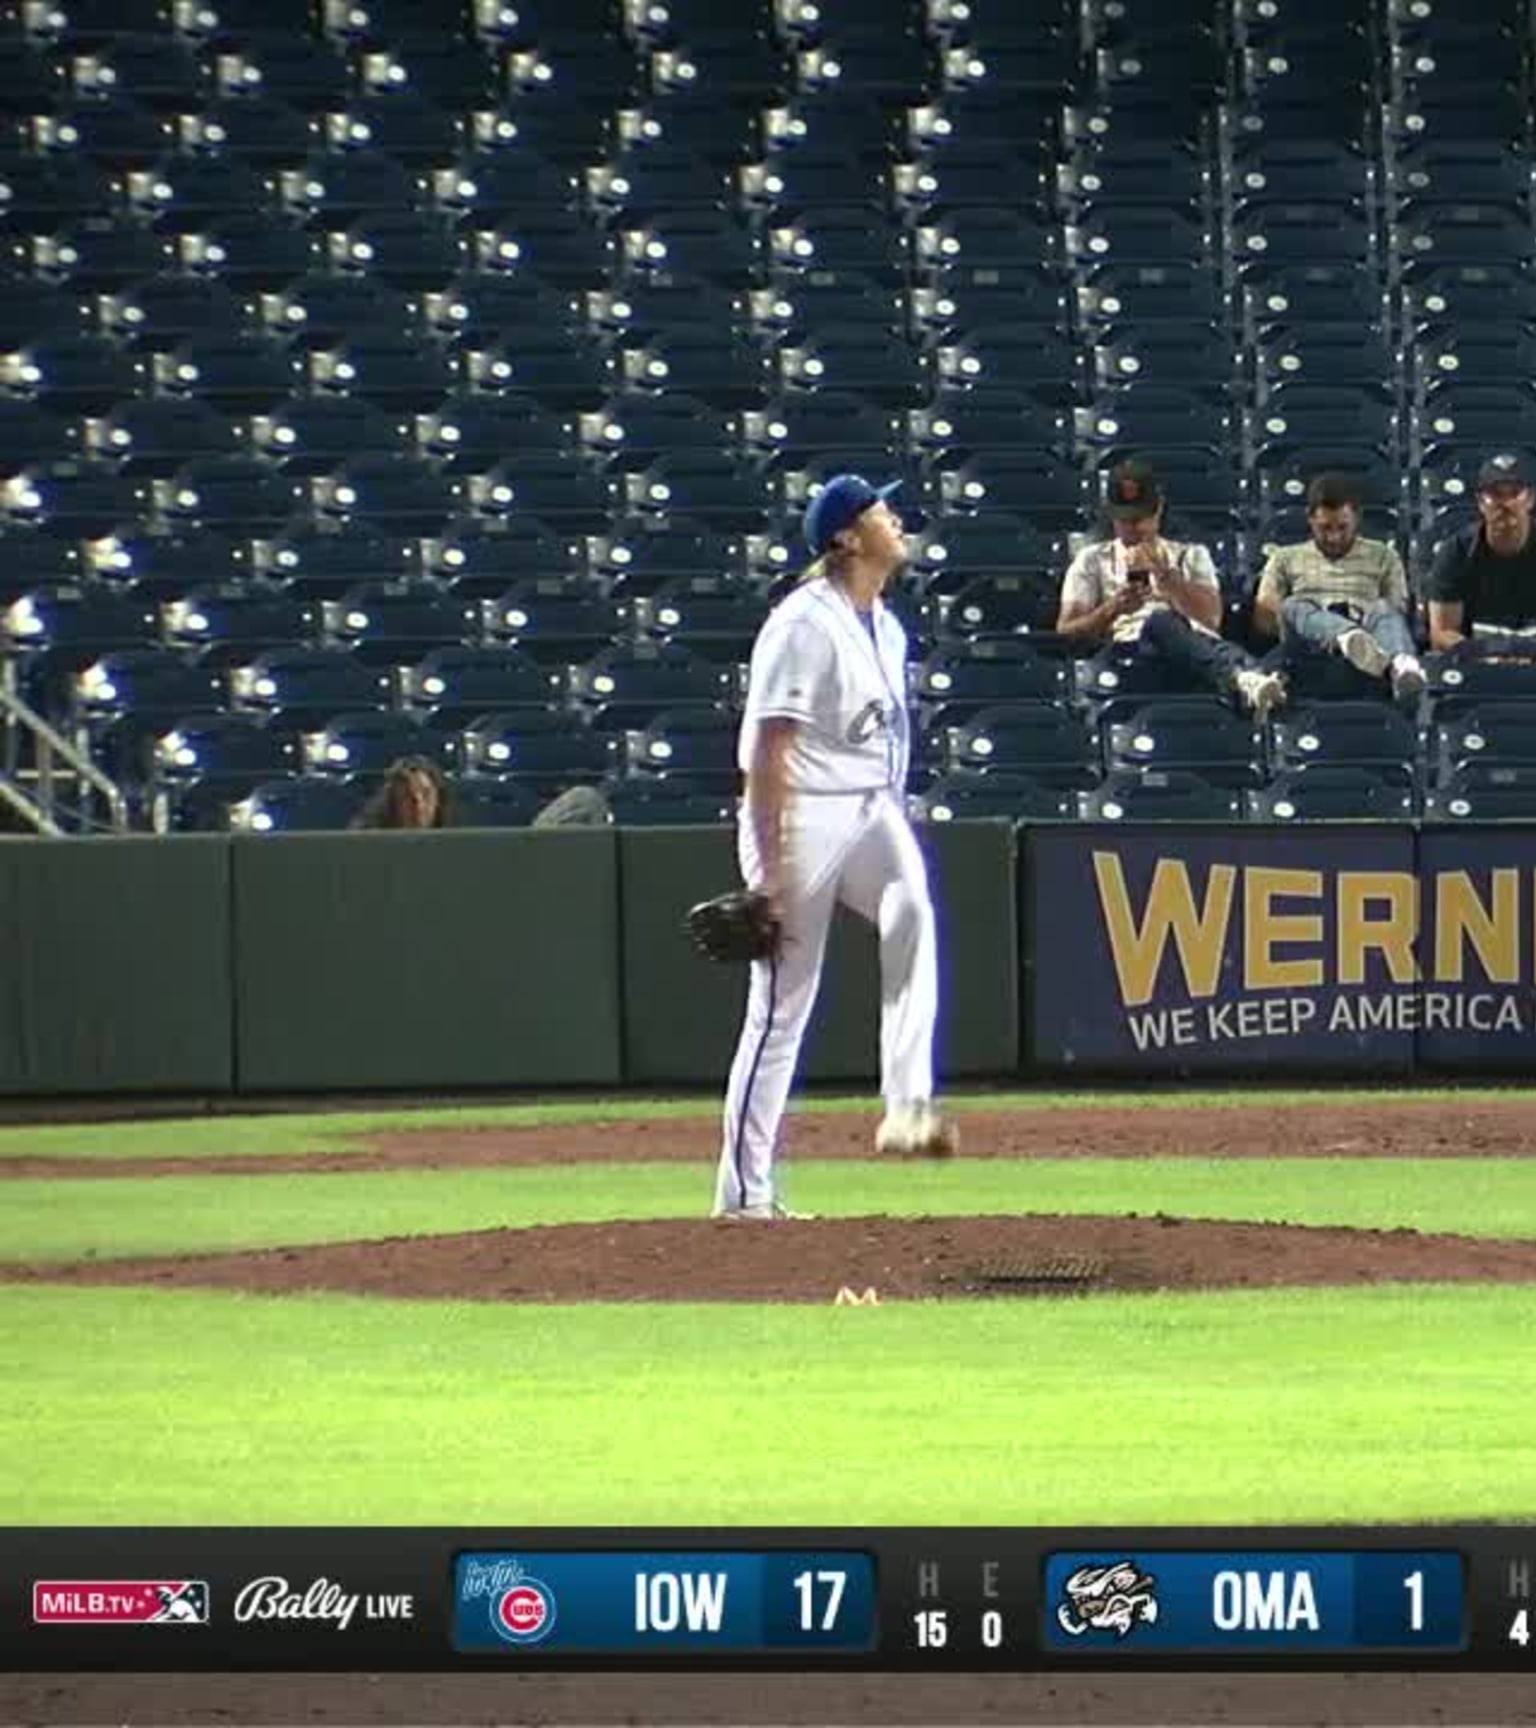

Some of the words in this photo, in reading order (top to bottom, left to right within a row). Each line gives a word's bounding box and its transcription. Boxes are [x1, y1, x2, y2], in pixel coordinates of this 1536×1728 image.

[1128, 1009, 1196, 1051] WE
[1207, 998, 1316, 1041] KEEP
[1329, 993, 1524, 1033] AMERICA
